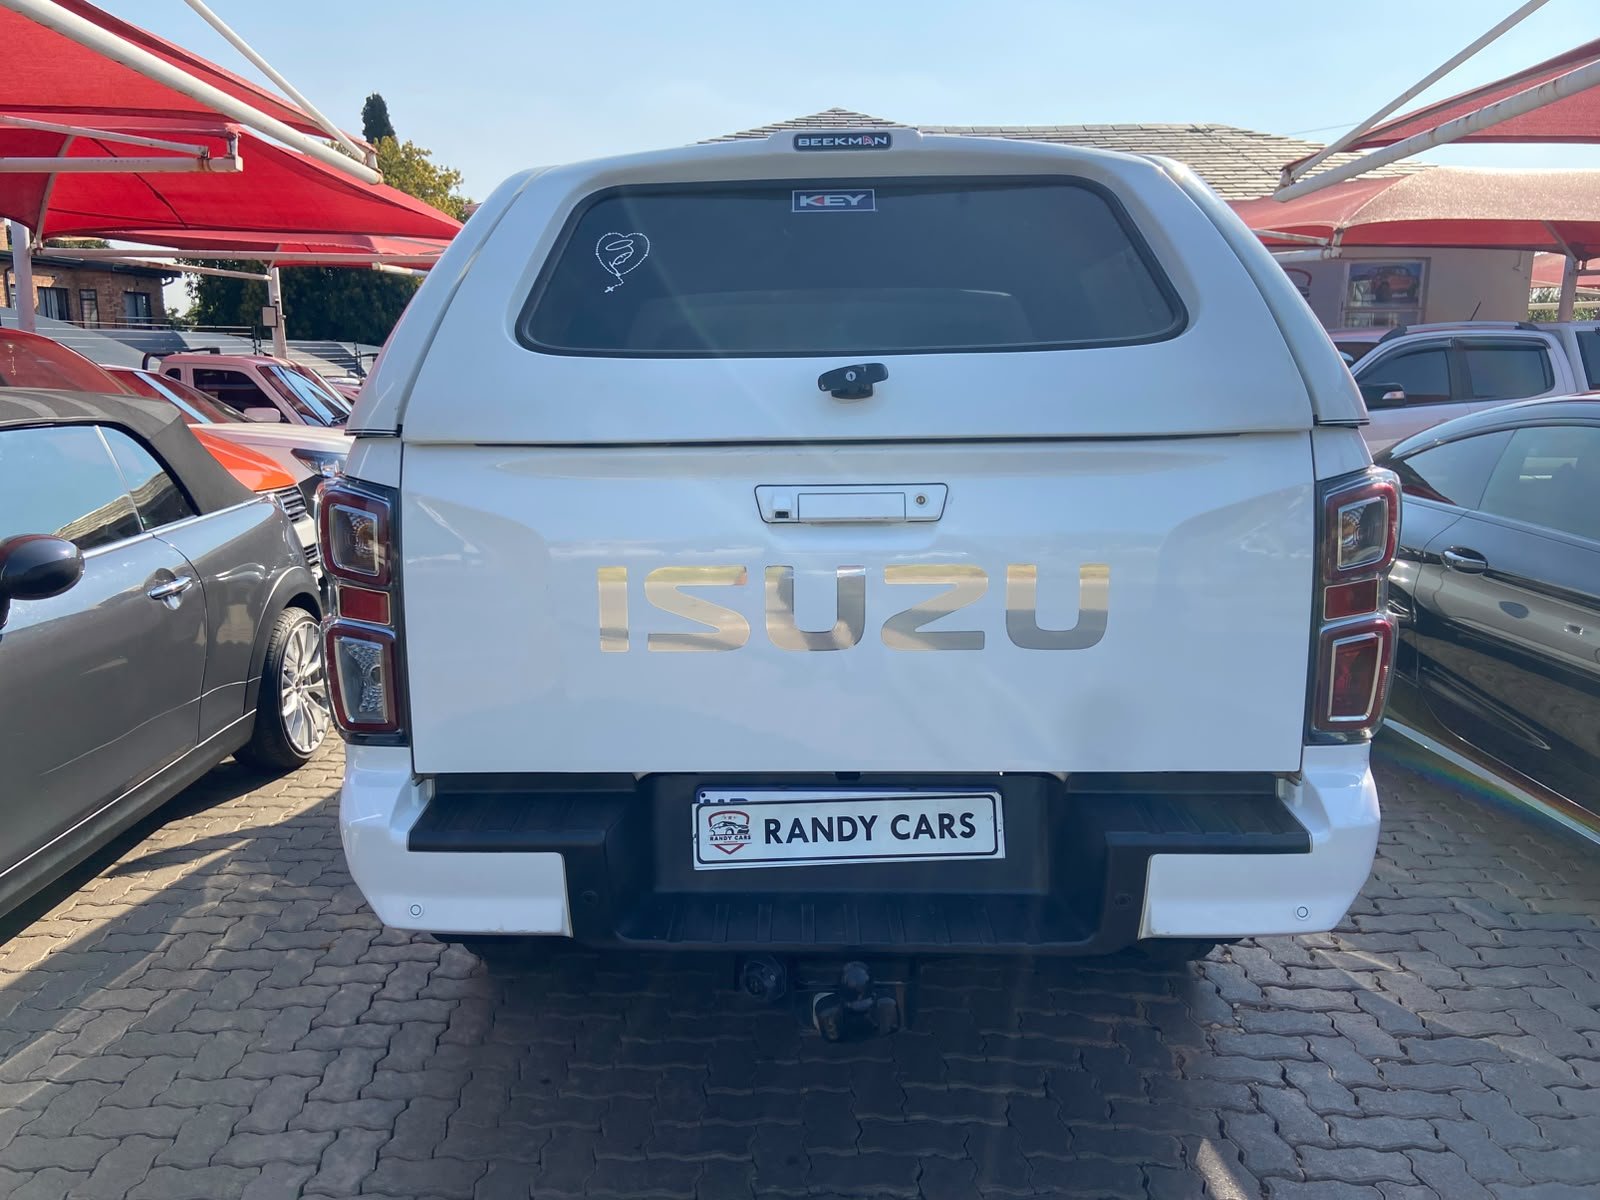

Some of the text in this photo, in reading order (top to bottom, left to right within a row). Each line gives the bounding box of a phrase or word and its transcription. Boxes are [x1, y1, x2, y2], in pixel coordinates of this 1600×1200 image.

[798, 135, 887, 147] BEEKMAN
[800, 194, 867, 207] KEY
[596, 564, 1110, 653] ISUZU
[764, 812, 976, 844] RANDY CARS
